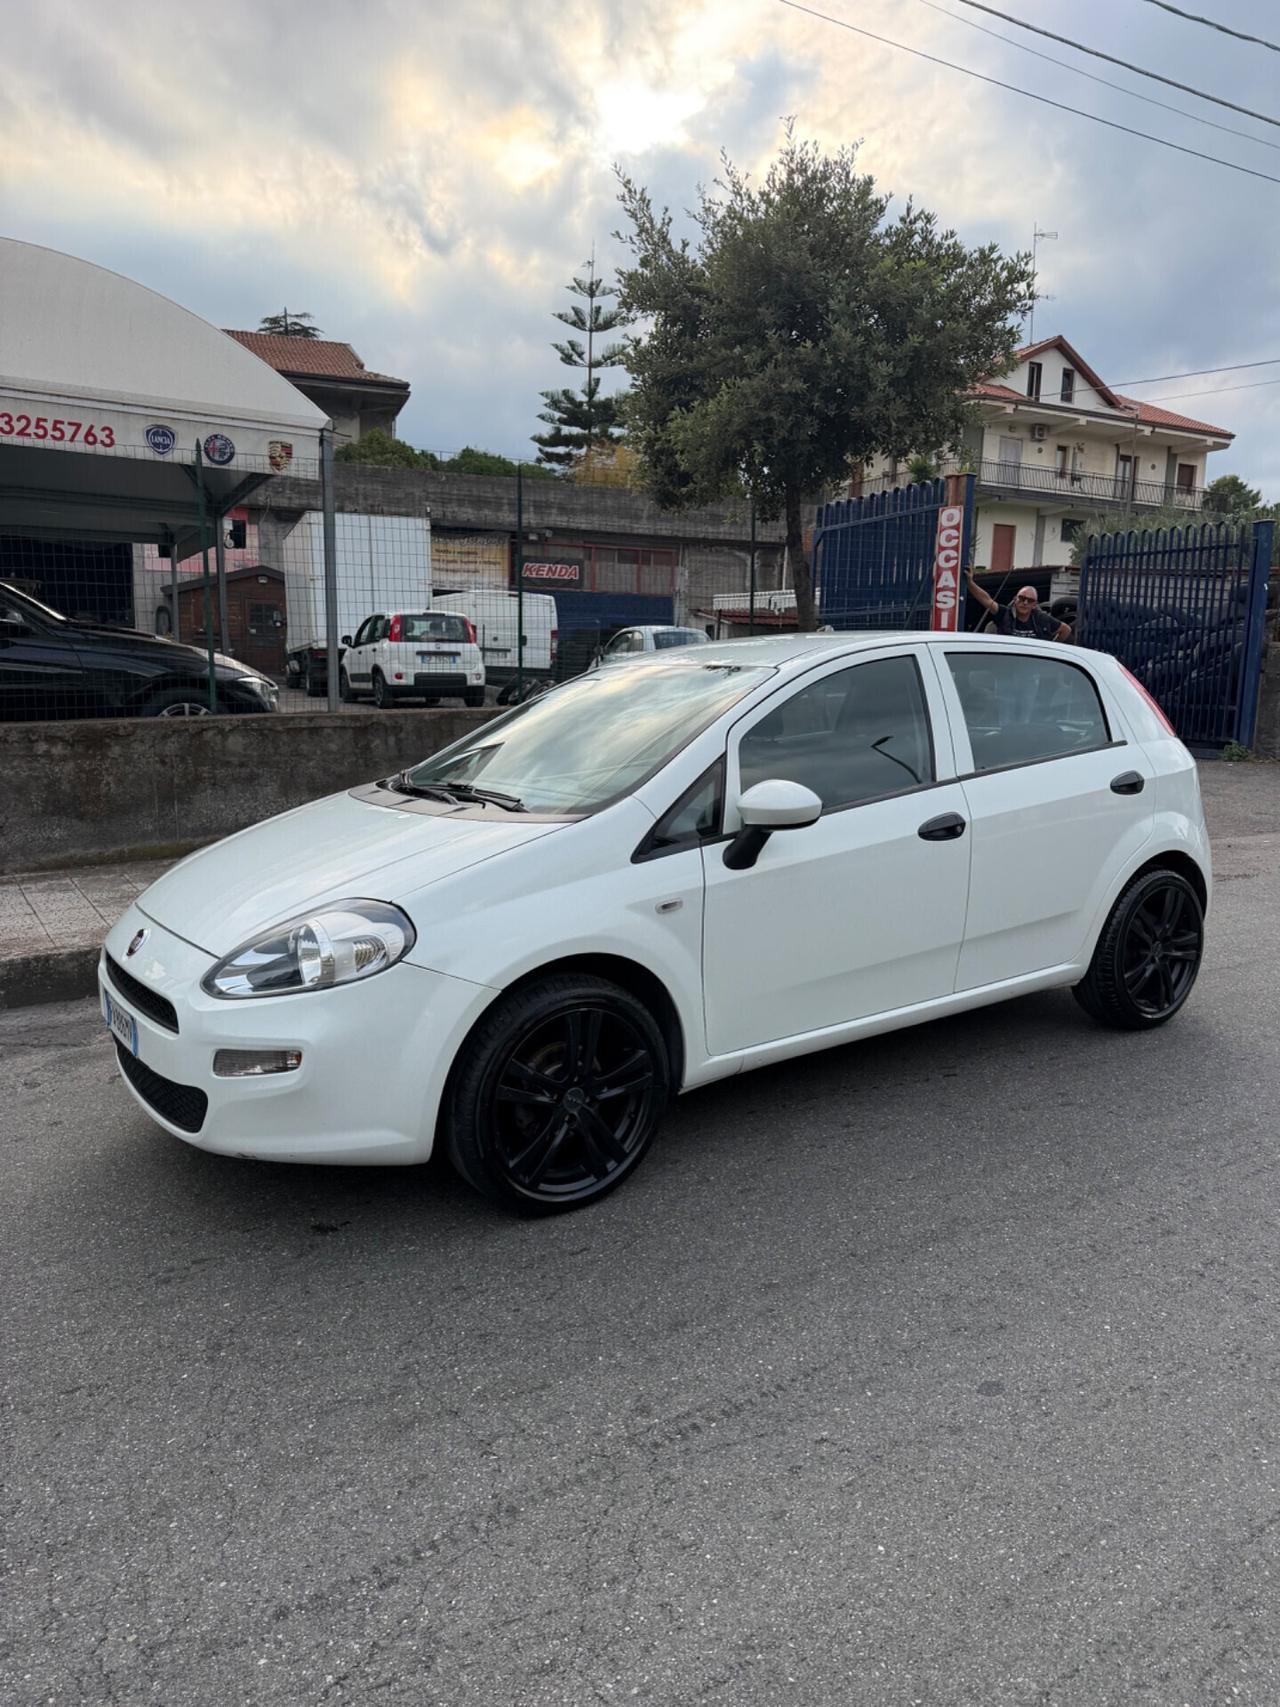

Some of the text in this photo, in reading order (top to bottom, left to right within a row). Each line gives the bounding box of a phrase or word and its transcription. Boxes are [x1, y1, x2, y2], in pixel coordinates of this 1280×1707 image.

[0, 412, 115, 448] 3255763
[522, 562, 579, 580] KENDA
[935, 508, 960, 629] OCCASI
